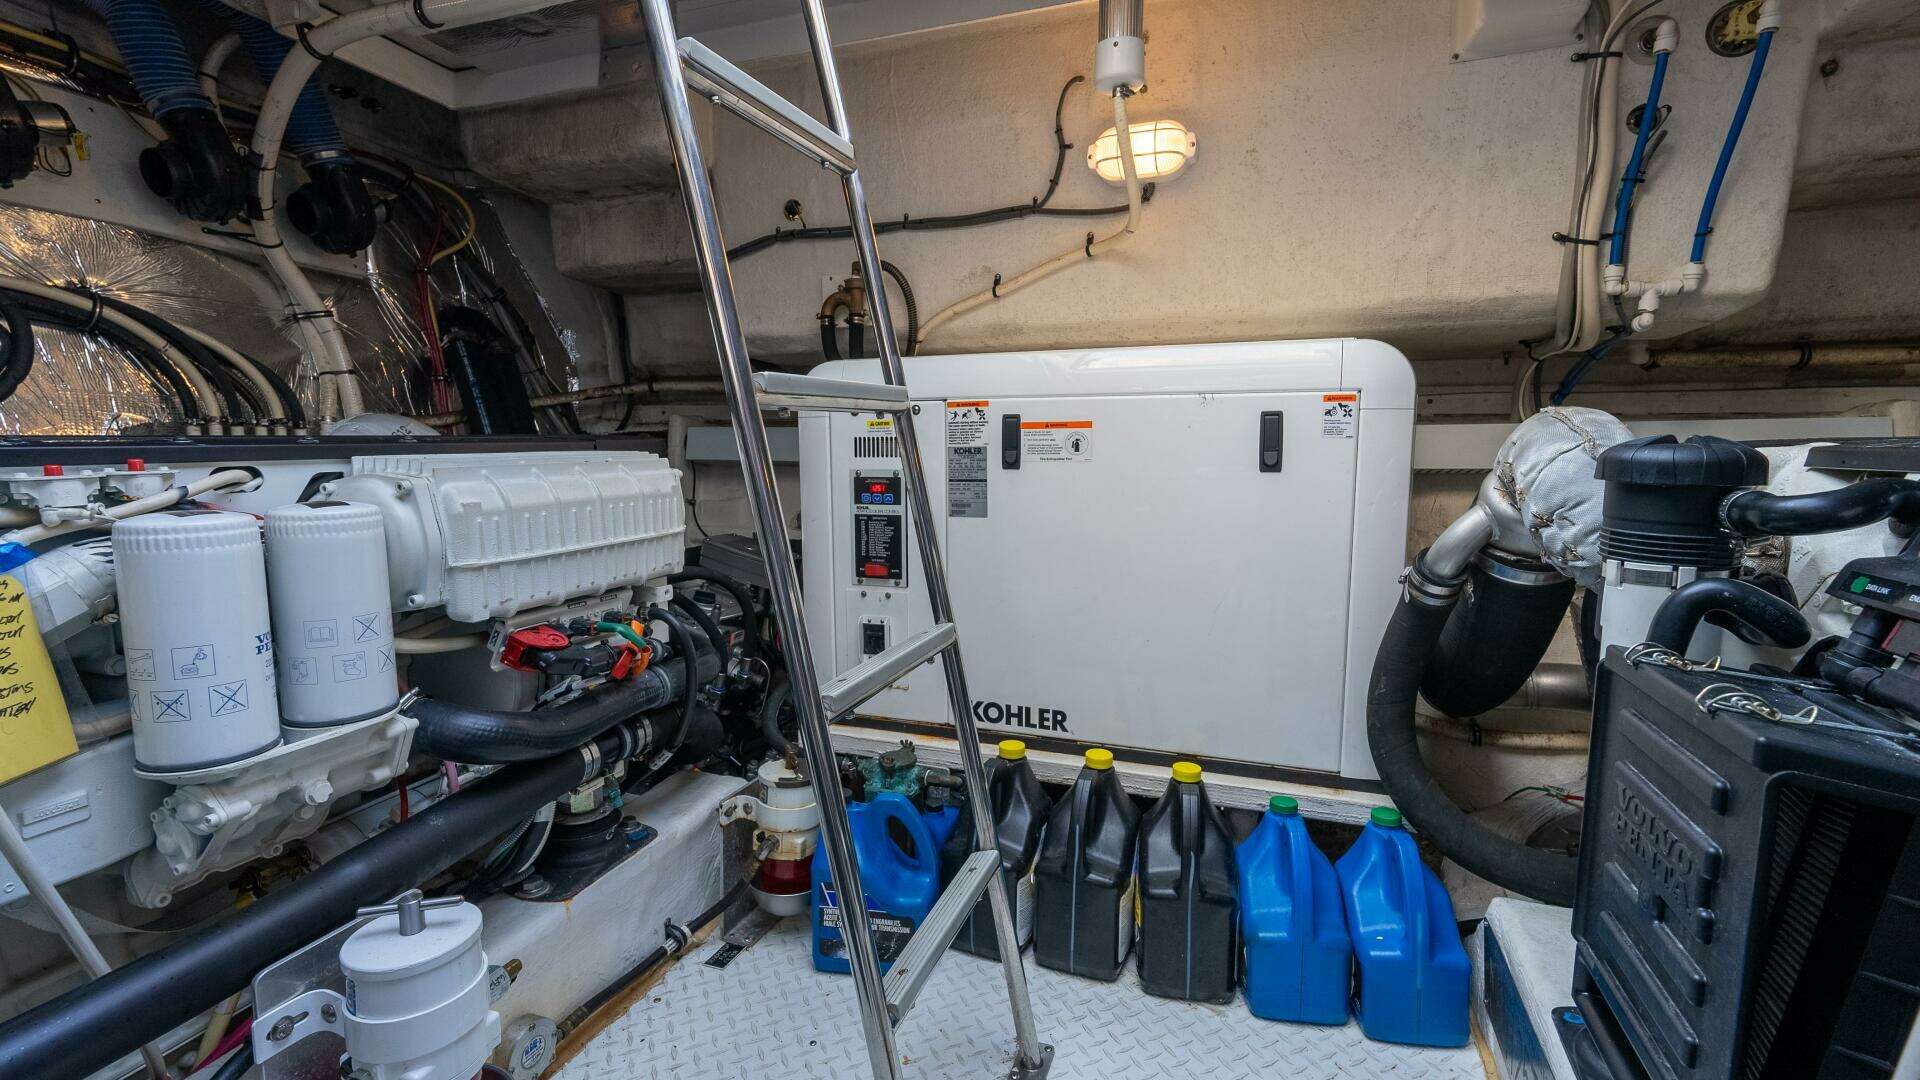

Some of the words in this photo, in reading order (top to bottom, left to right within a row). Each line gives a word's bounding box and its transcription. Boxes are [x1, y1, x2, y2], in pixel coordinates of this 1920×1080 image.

[953, 447, 983, 455] KOHLER
[971, 701, 1069, 733] KOHLER
[1615, 780, 1694, 876] VOLVO
[1615, 810, 1693, 918] PENTA
[878, 925, 911, 934] TRANSMISSION
